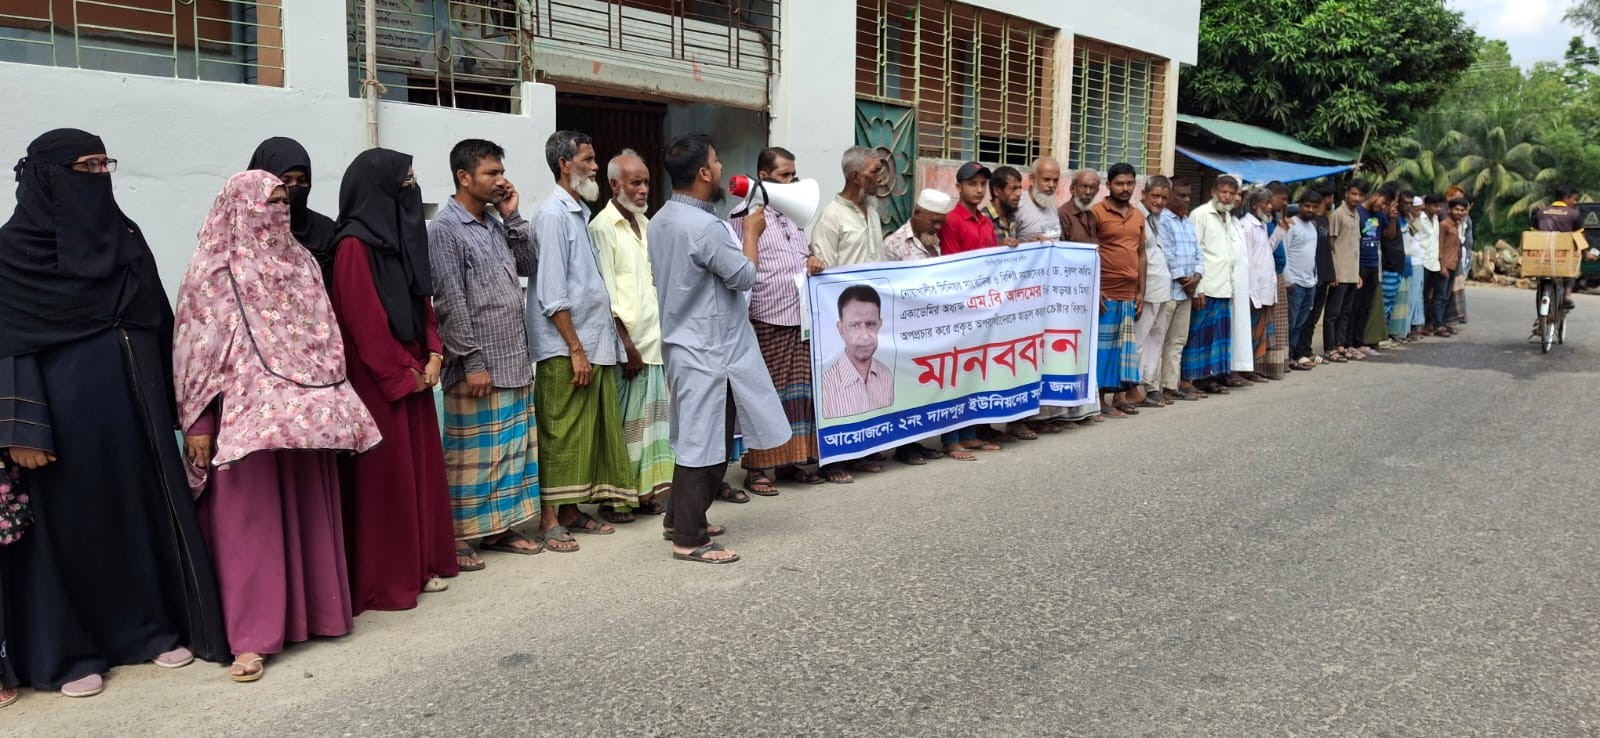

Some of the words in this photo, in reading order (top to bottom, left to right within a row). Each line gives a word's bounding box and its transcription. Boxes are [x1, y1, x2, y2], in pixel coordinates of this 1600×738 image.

[900, 304, 940, 320] একাডেমির
[1005, 285, 1042, 302] আলমের
[900, 328, 932, 340] অপপ্রচার
[935, 325, 951, 335] করে
[953, 321, 973, 336] প্রকৃত
[898, 415, 923, 430] ২নং
[926, 402, 966, 423] দাদপুর
[968, 390, 1029, 412] ইউনিয়নের
